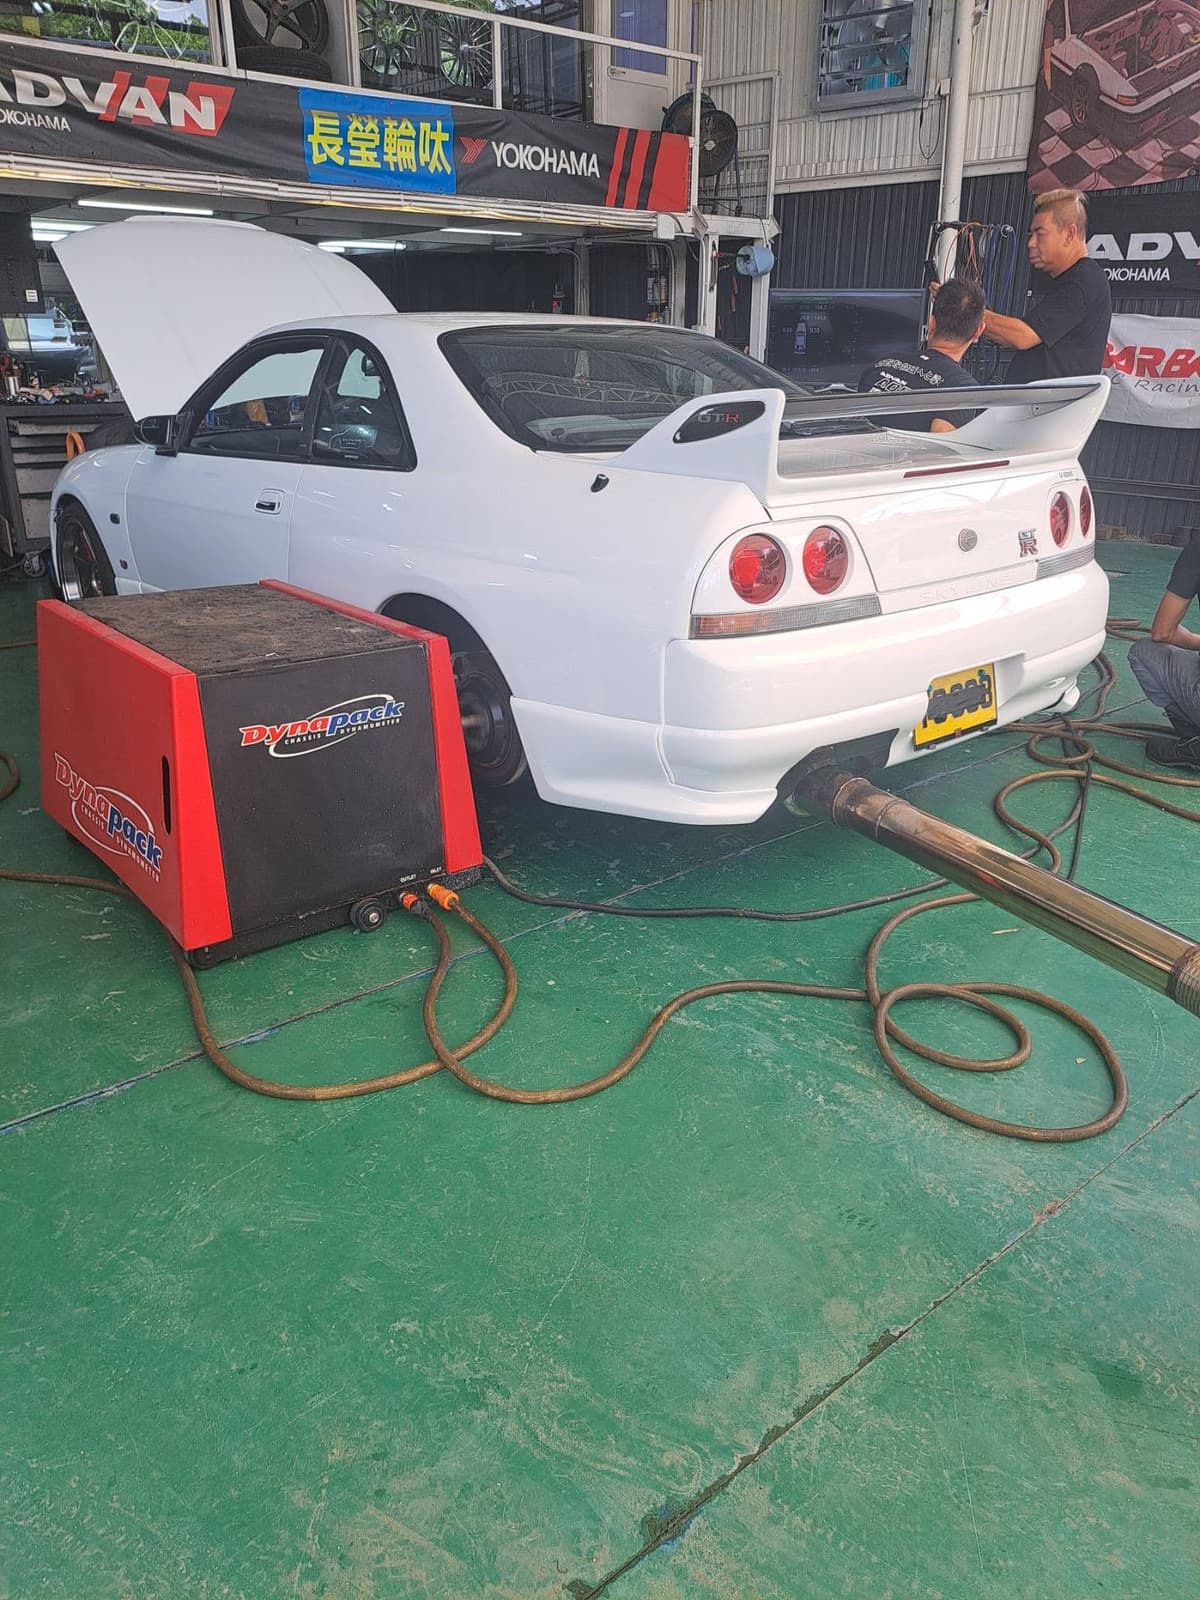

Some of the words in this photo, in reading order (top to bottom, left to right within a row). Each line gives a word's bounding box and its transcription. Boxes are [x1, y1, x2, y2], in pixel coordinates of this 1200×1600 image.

[307, 109, 452, 175] 長瑩輪呔
[491, 141, 601, 179] YOKOHAMA
[1134, 379, 1200, 394] Racin
[240, 701, 405, 746] Dynapack
[284, 733, 321, 745] CHASSIS
[340, 718, 400, 735] DYNAMOMETER
[55, 751, 163, 873] Dynapack
